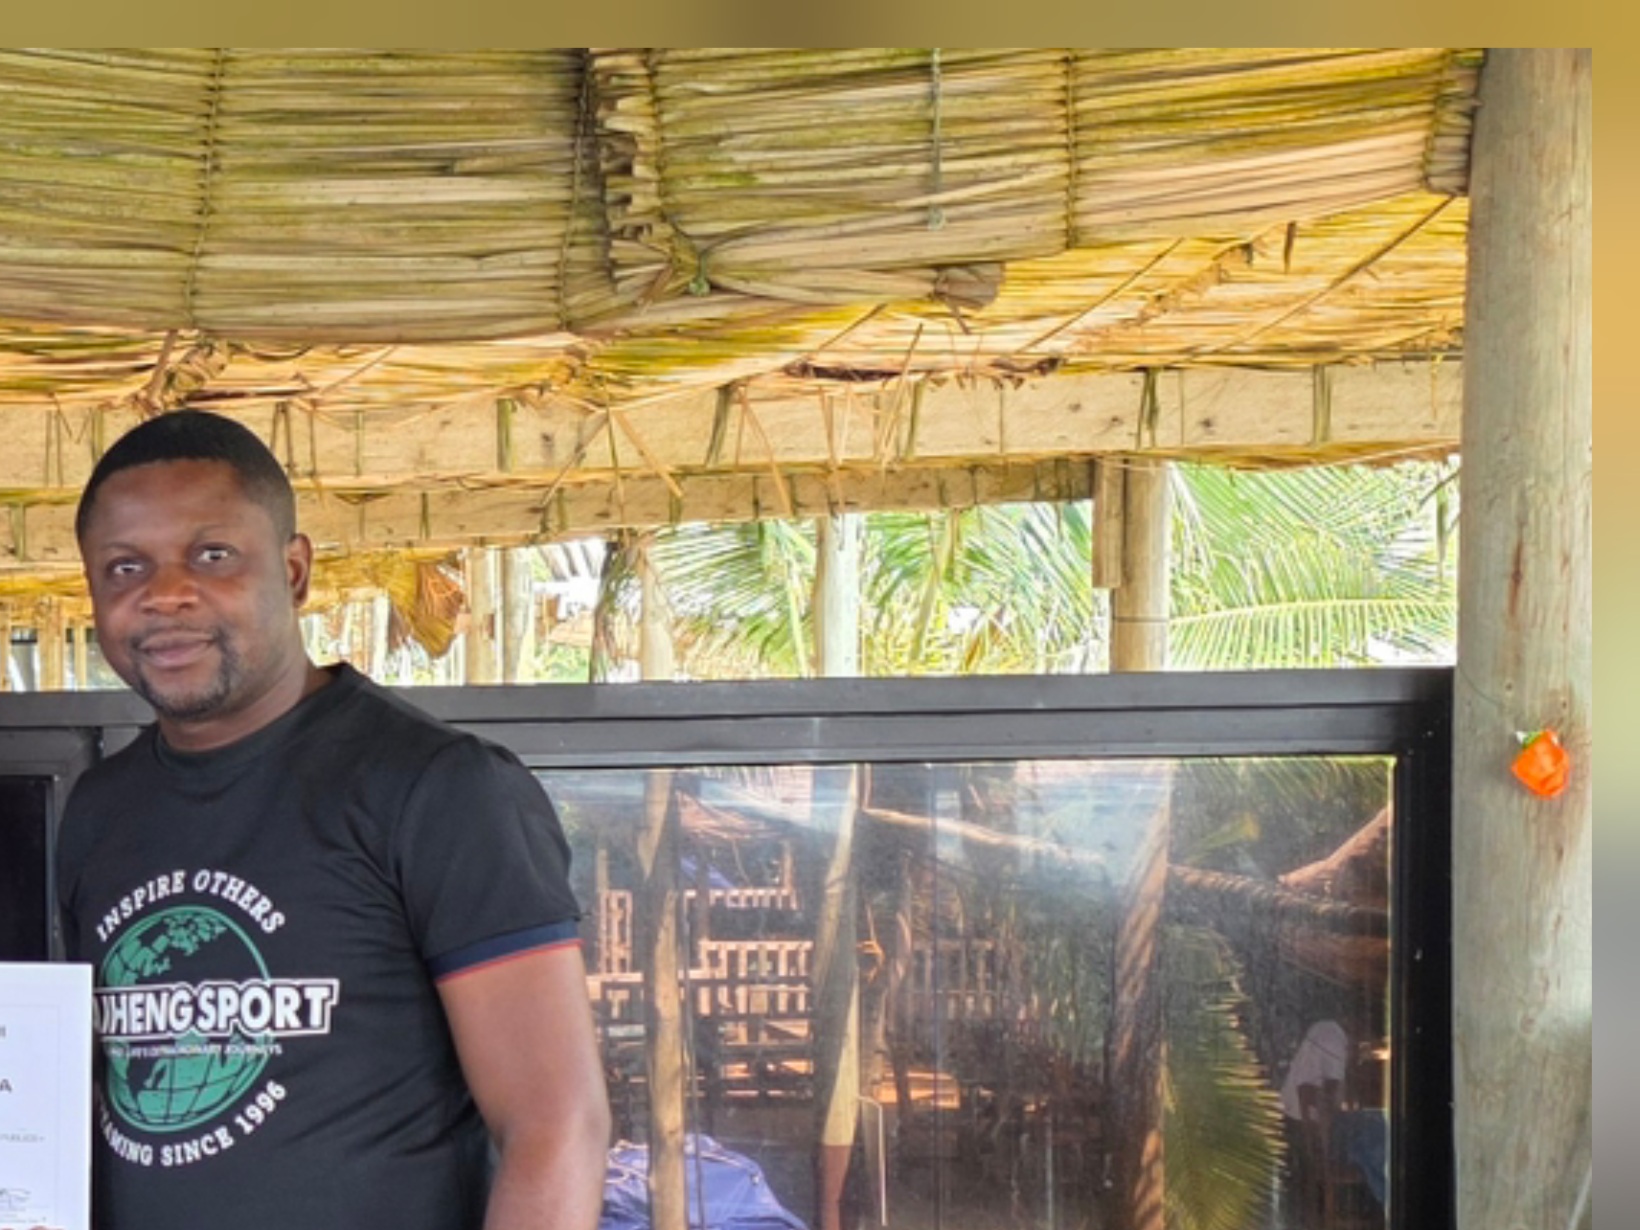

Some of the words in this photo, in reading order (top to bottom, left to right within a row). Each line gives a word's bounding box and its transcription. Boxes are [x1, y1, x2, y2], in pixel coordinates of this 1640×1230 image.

[95, 869, 186, 942] INSPIRE
[192, 868, 287, 934] OTHERS
[159, 1124, 236, 1167] SINCE
[234, 1079, 288, 1136] 1996
